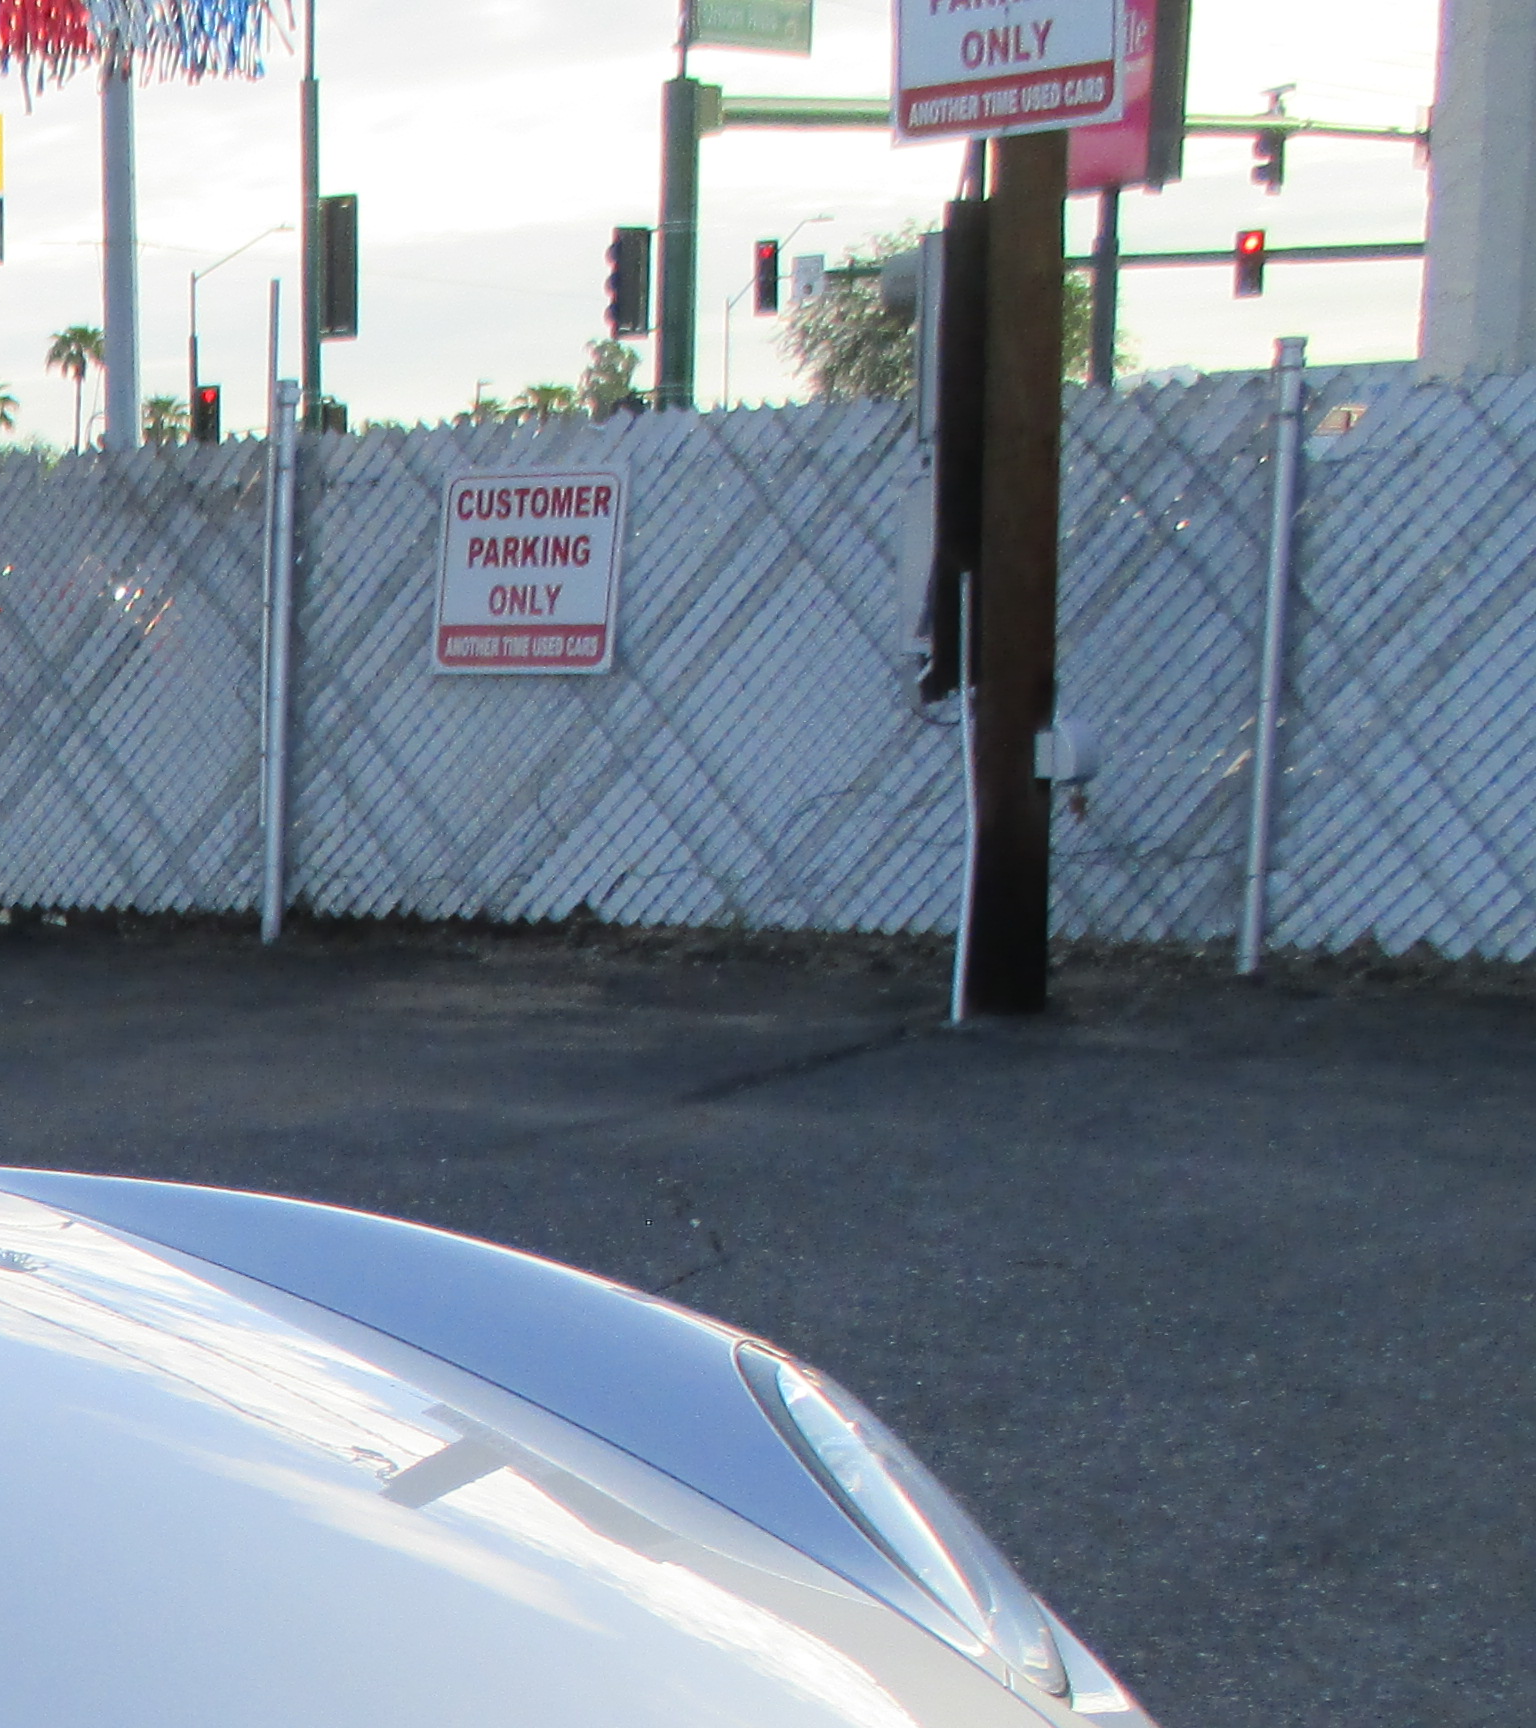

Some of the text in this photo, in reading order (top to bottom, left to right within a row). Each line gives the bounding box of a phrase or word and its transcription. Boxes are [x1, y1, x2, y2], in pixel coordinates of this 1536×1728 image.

[961, 19, 1053, 69] ONLY
[908, 76, 1105, 128] ANOTHER TIME USED CARS
[457, 485, 612, 521] CUSTOMER
[468, 534, 591, 569] PARKING
[488, 582, 564, 617] ONLY
